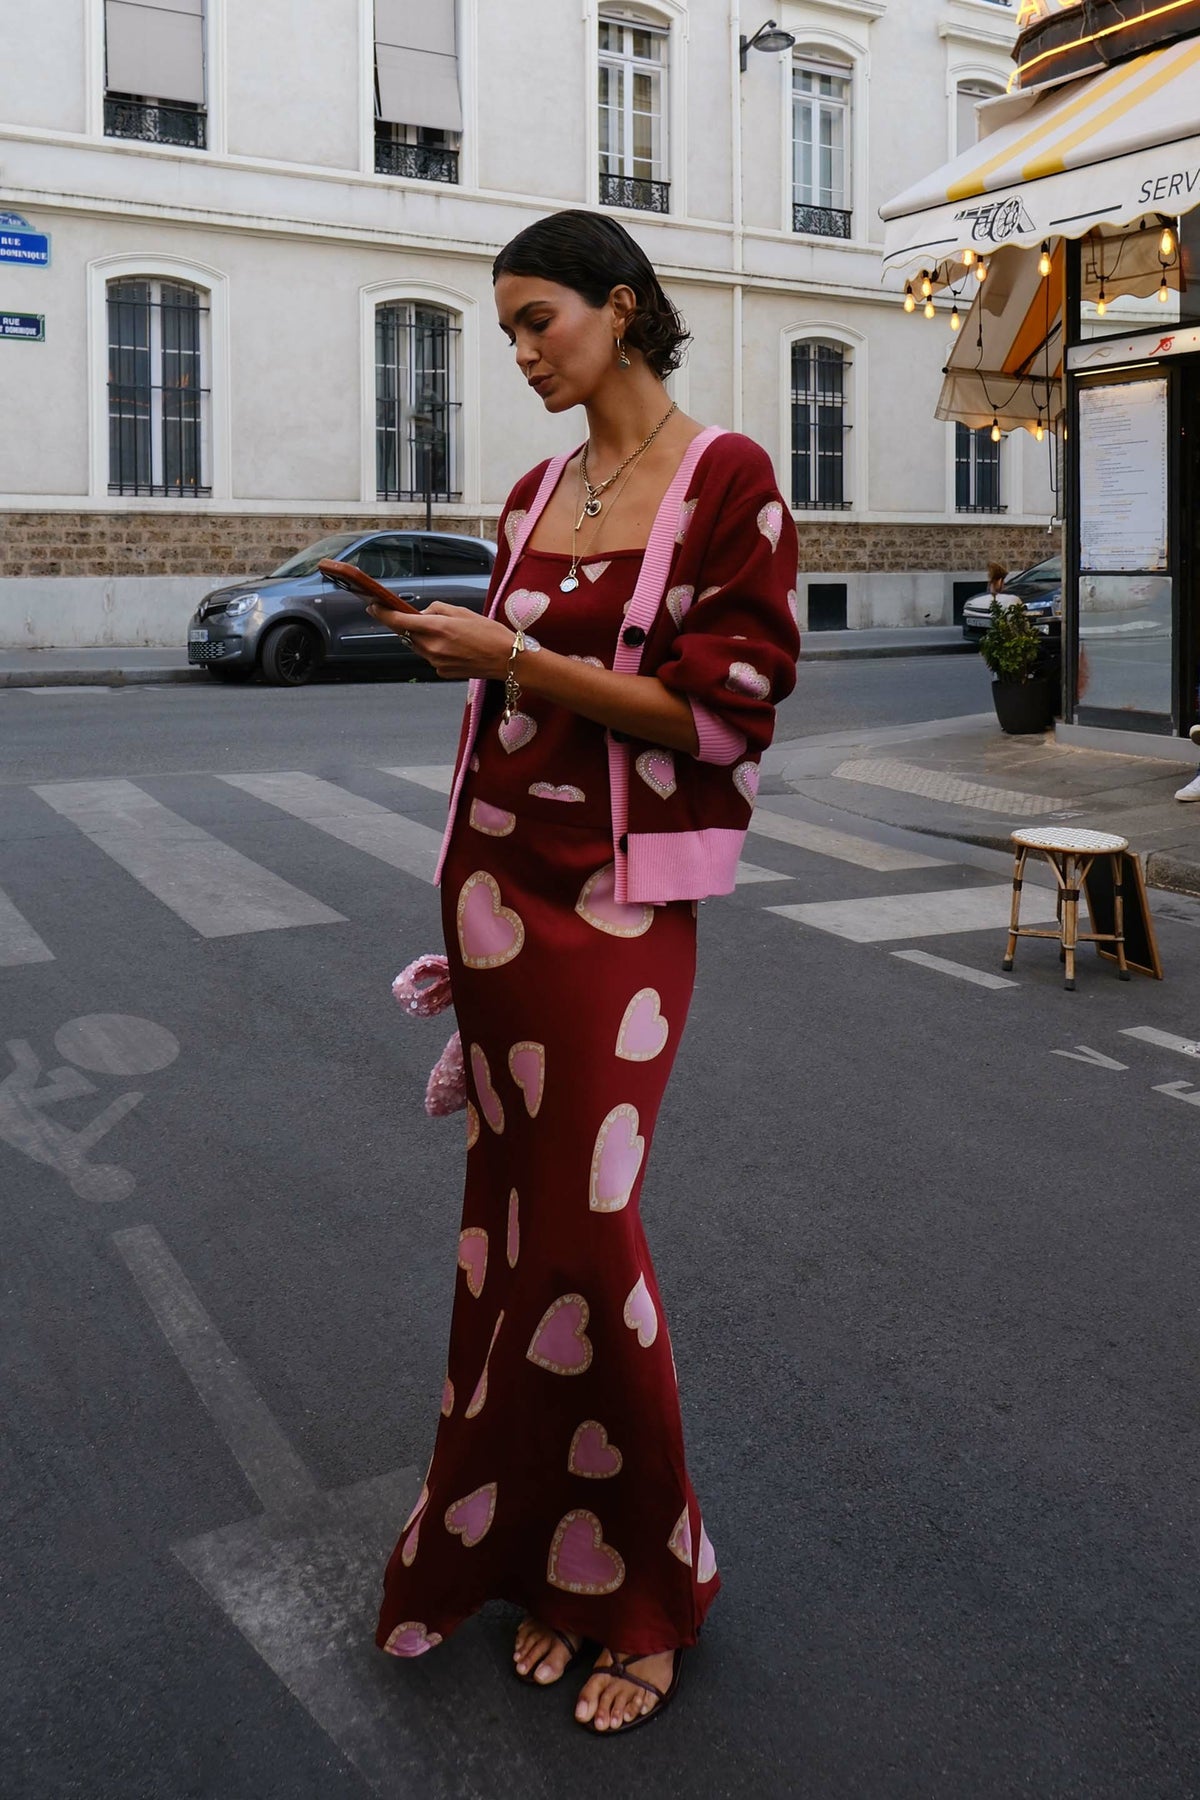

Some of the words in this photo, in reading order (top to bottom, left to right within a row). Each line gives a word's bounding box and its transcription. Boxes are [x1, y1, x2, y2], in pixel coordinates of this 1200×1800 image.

[1138, 168, 1200, 203] SERV
[1, 237, 21, 246] RUE
[0, 248, 48, 260] DOMINIQUE
[3, 317, 20, 326] RUE
